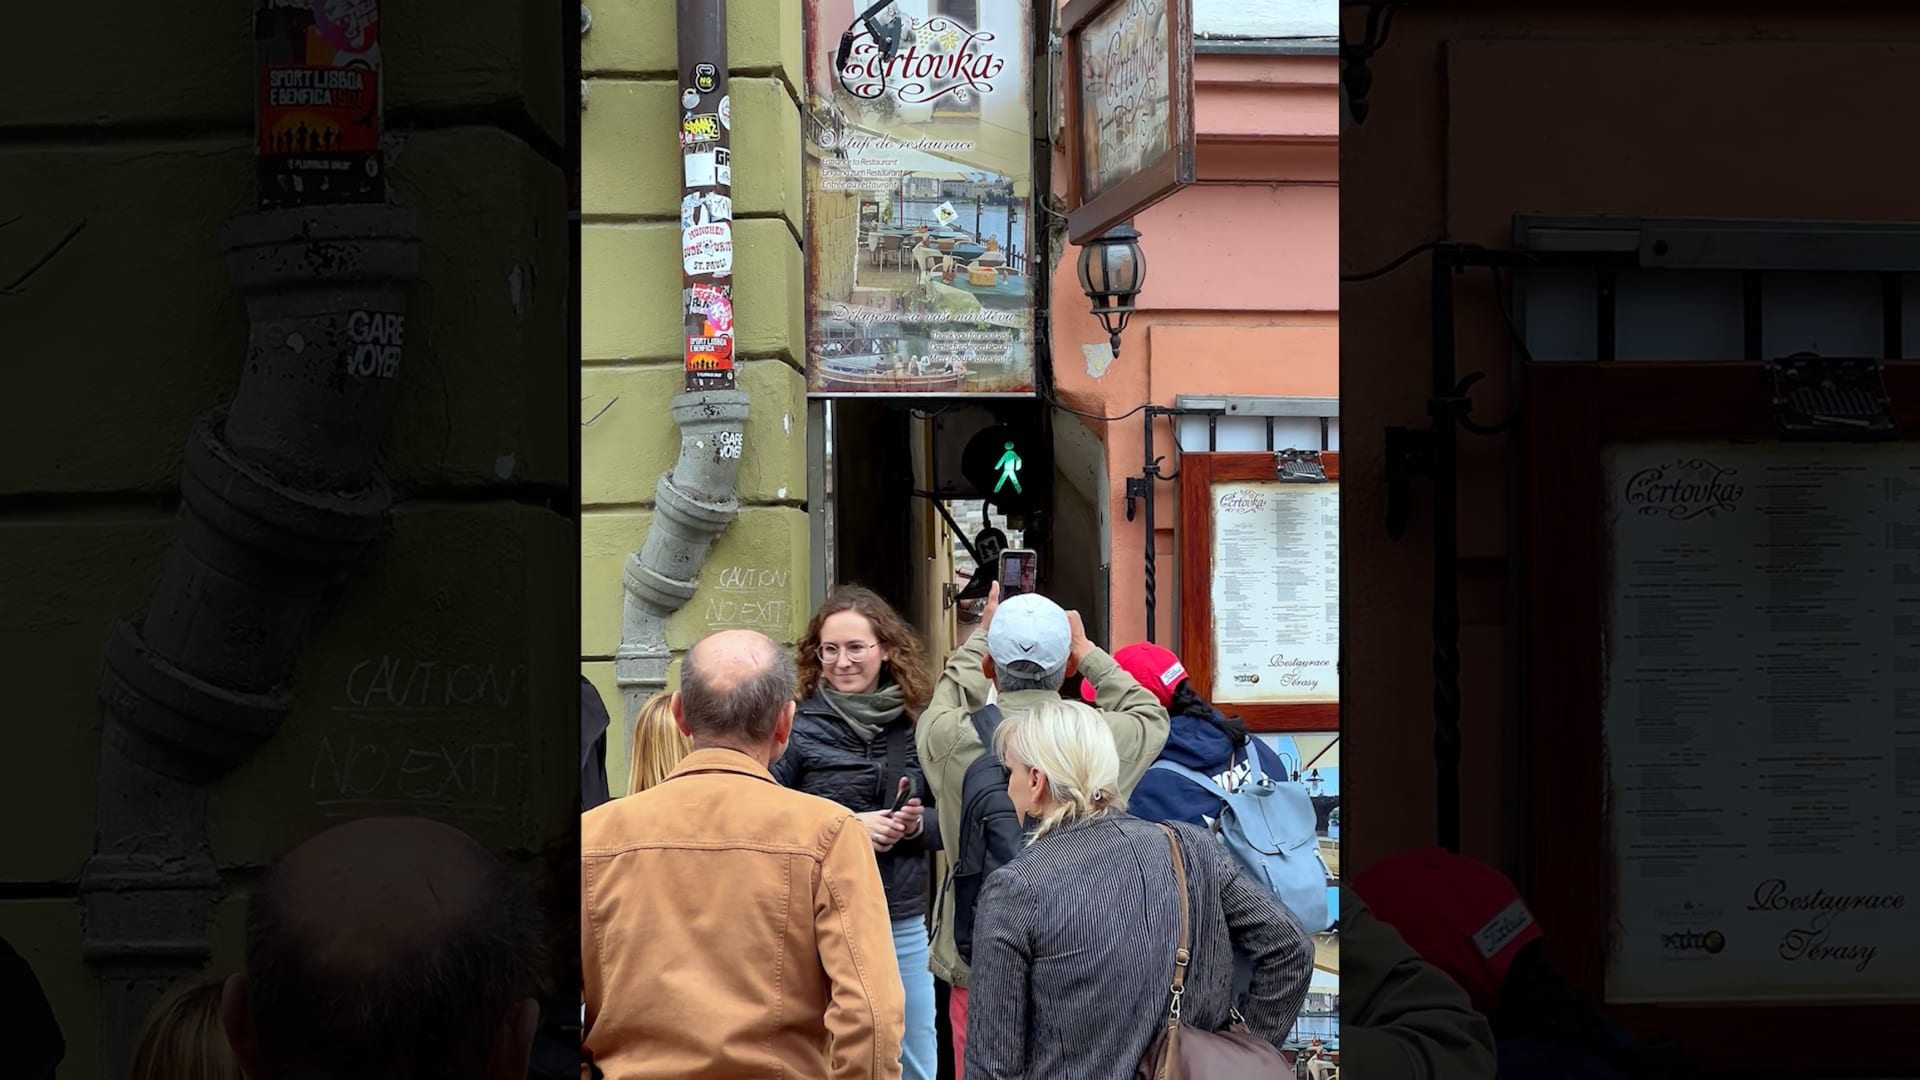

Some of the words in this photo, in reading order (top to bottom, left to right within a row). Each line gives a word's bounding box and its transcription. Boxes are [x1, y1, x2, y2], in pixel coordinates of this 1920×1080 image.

[314, 70, 363, 89] LISBOA
[278, 88, 332, 105] BENFICA
[876, 134, 892, 150] do
[898, 137, 976, 152] restaurace
[861, 158, 898, 166] Restaurant
[347, 311, 404, 345] GARE
[719, 566, 787, 588] CAUTION
[705, 598, 737, 622] NO
[739, 600, 787, 624] EXIT
[345, 655, 515, 708] CAUTION
[308, 735, 390, 795] NO
[397, 742, 518, 799] EXIT
